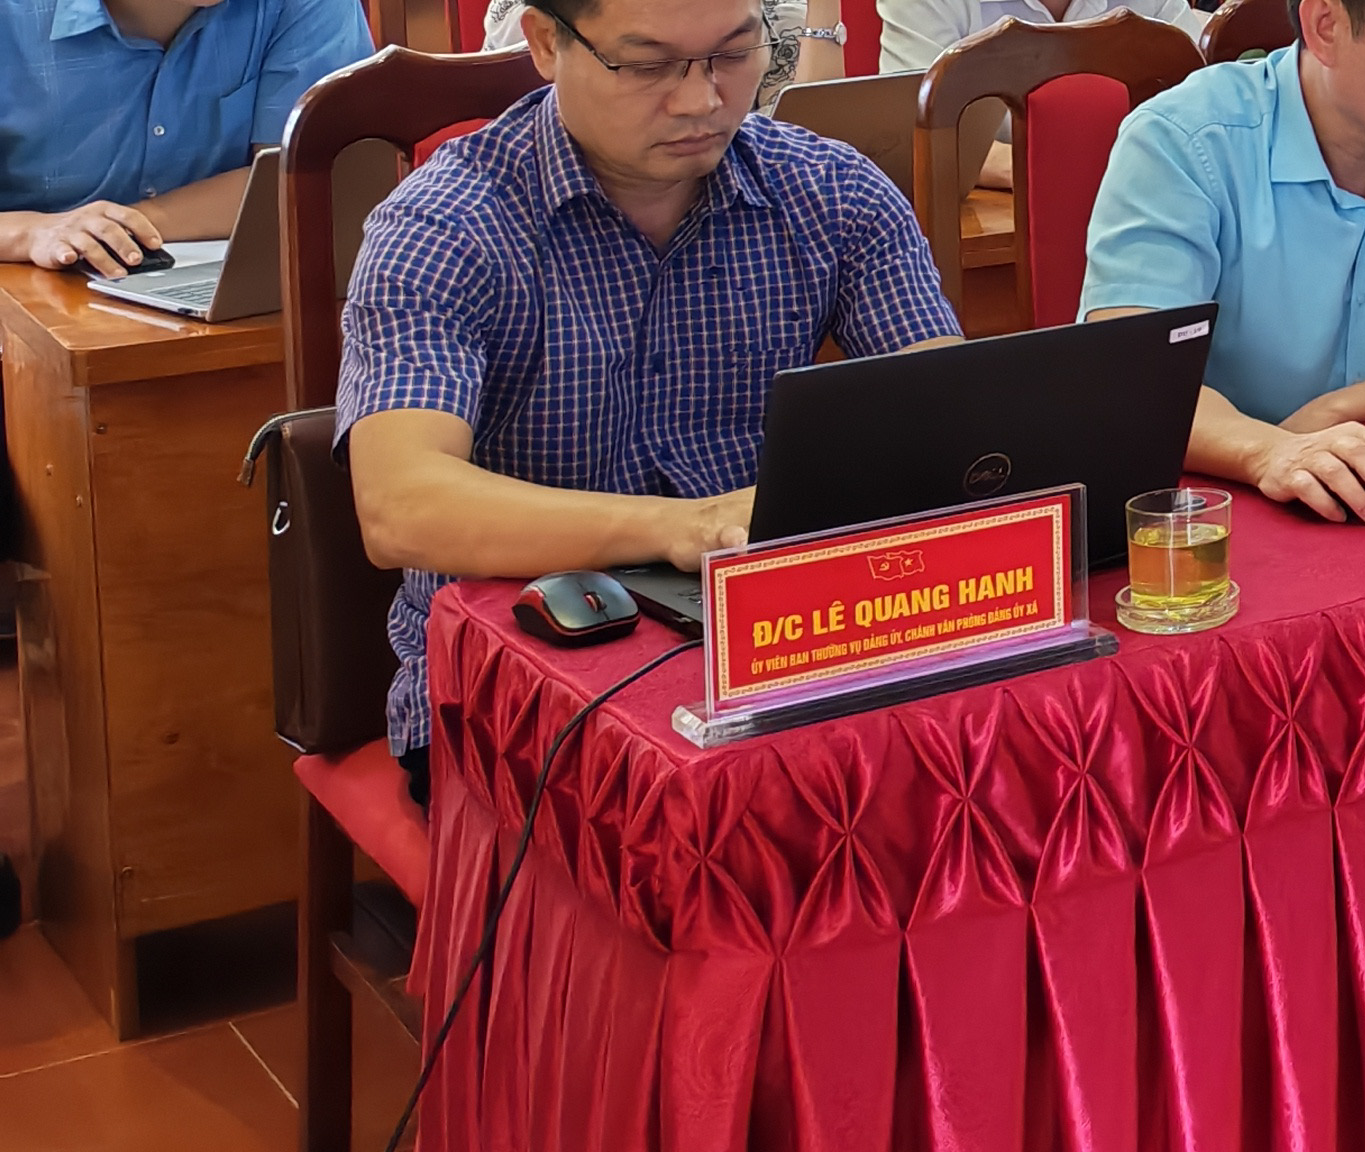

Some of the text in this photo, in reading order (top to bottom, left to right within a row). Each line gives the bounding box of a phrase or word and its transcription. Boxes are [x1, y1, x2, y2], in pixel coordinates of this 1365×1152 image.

[752, 566, 1033, 649] Đ/C LÊ QUANG HANH
[765, 655, 788, 672] VIÊN
[790, 651, 809, 667] BAN
[905, 621, 936, 642] CHÁNH
[937, 619, 955, 634] VĂN
[957, 613, 987, 631] PHÒNG
